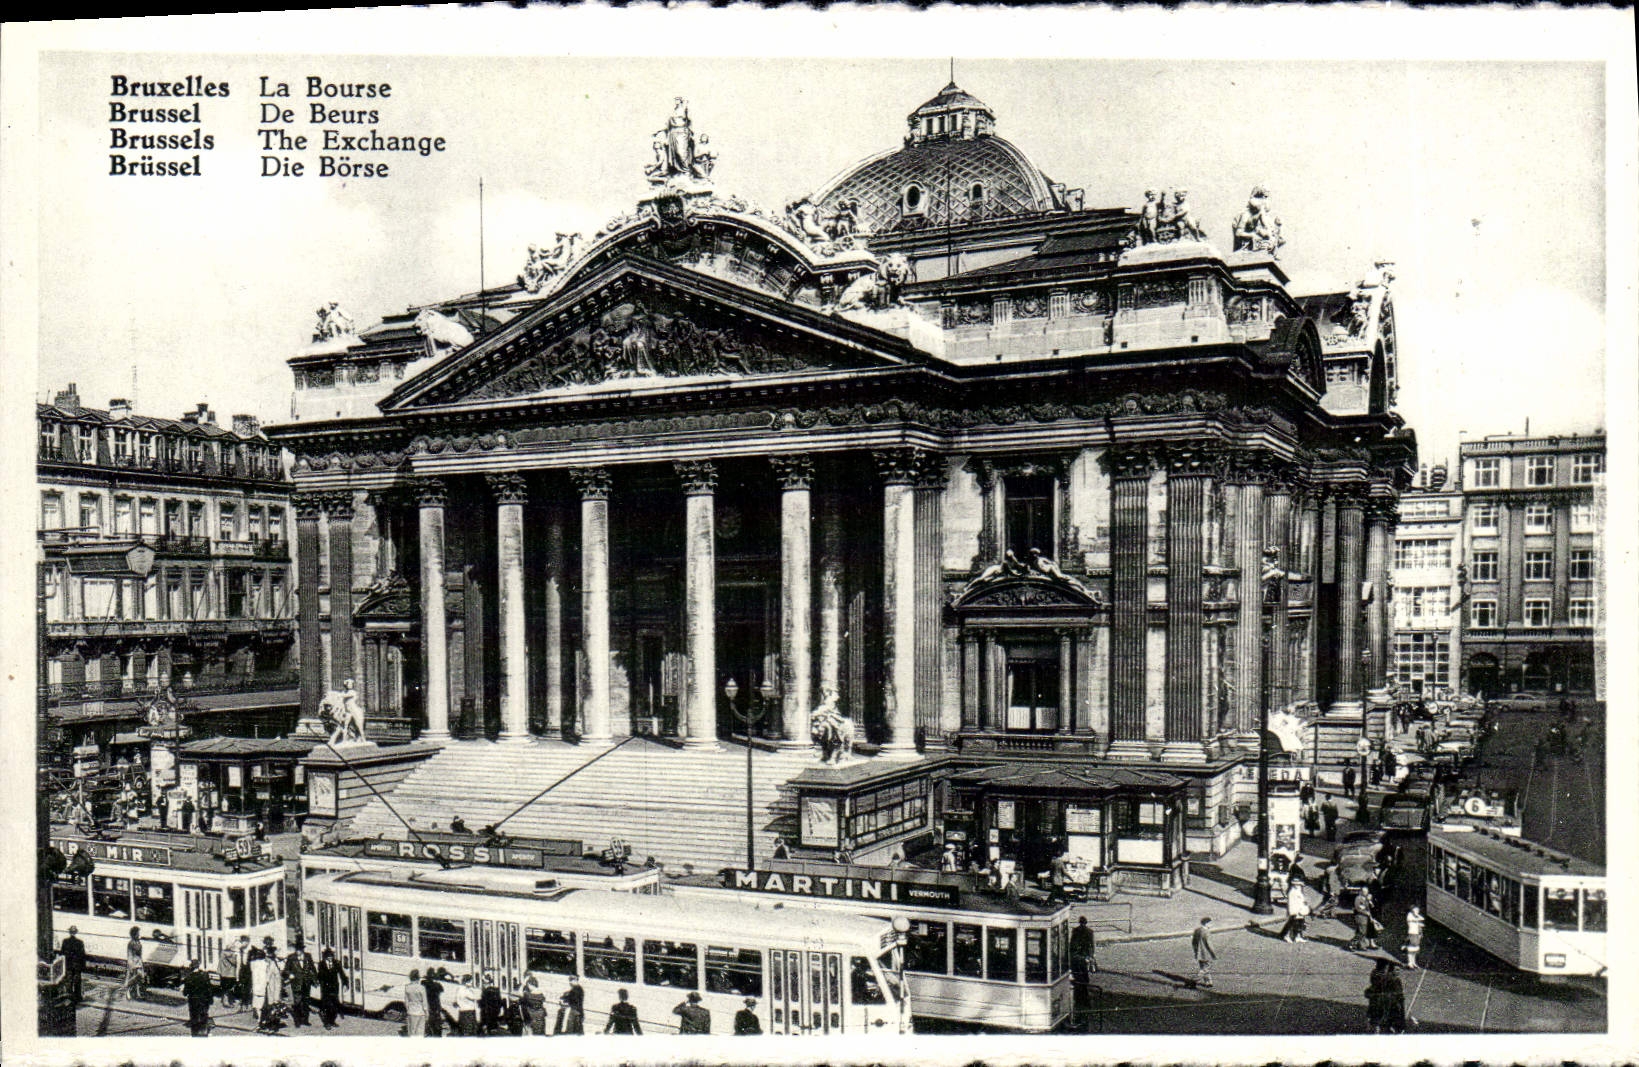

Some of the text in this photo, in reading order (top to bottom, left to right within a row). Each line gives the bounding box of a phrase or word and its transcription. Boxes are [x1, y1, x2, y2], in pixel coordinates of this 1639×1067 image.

[399, 842, 505, 864] ROSSI
[735, 870, 950, 900] MARTINI VERMOUTH
